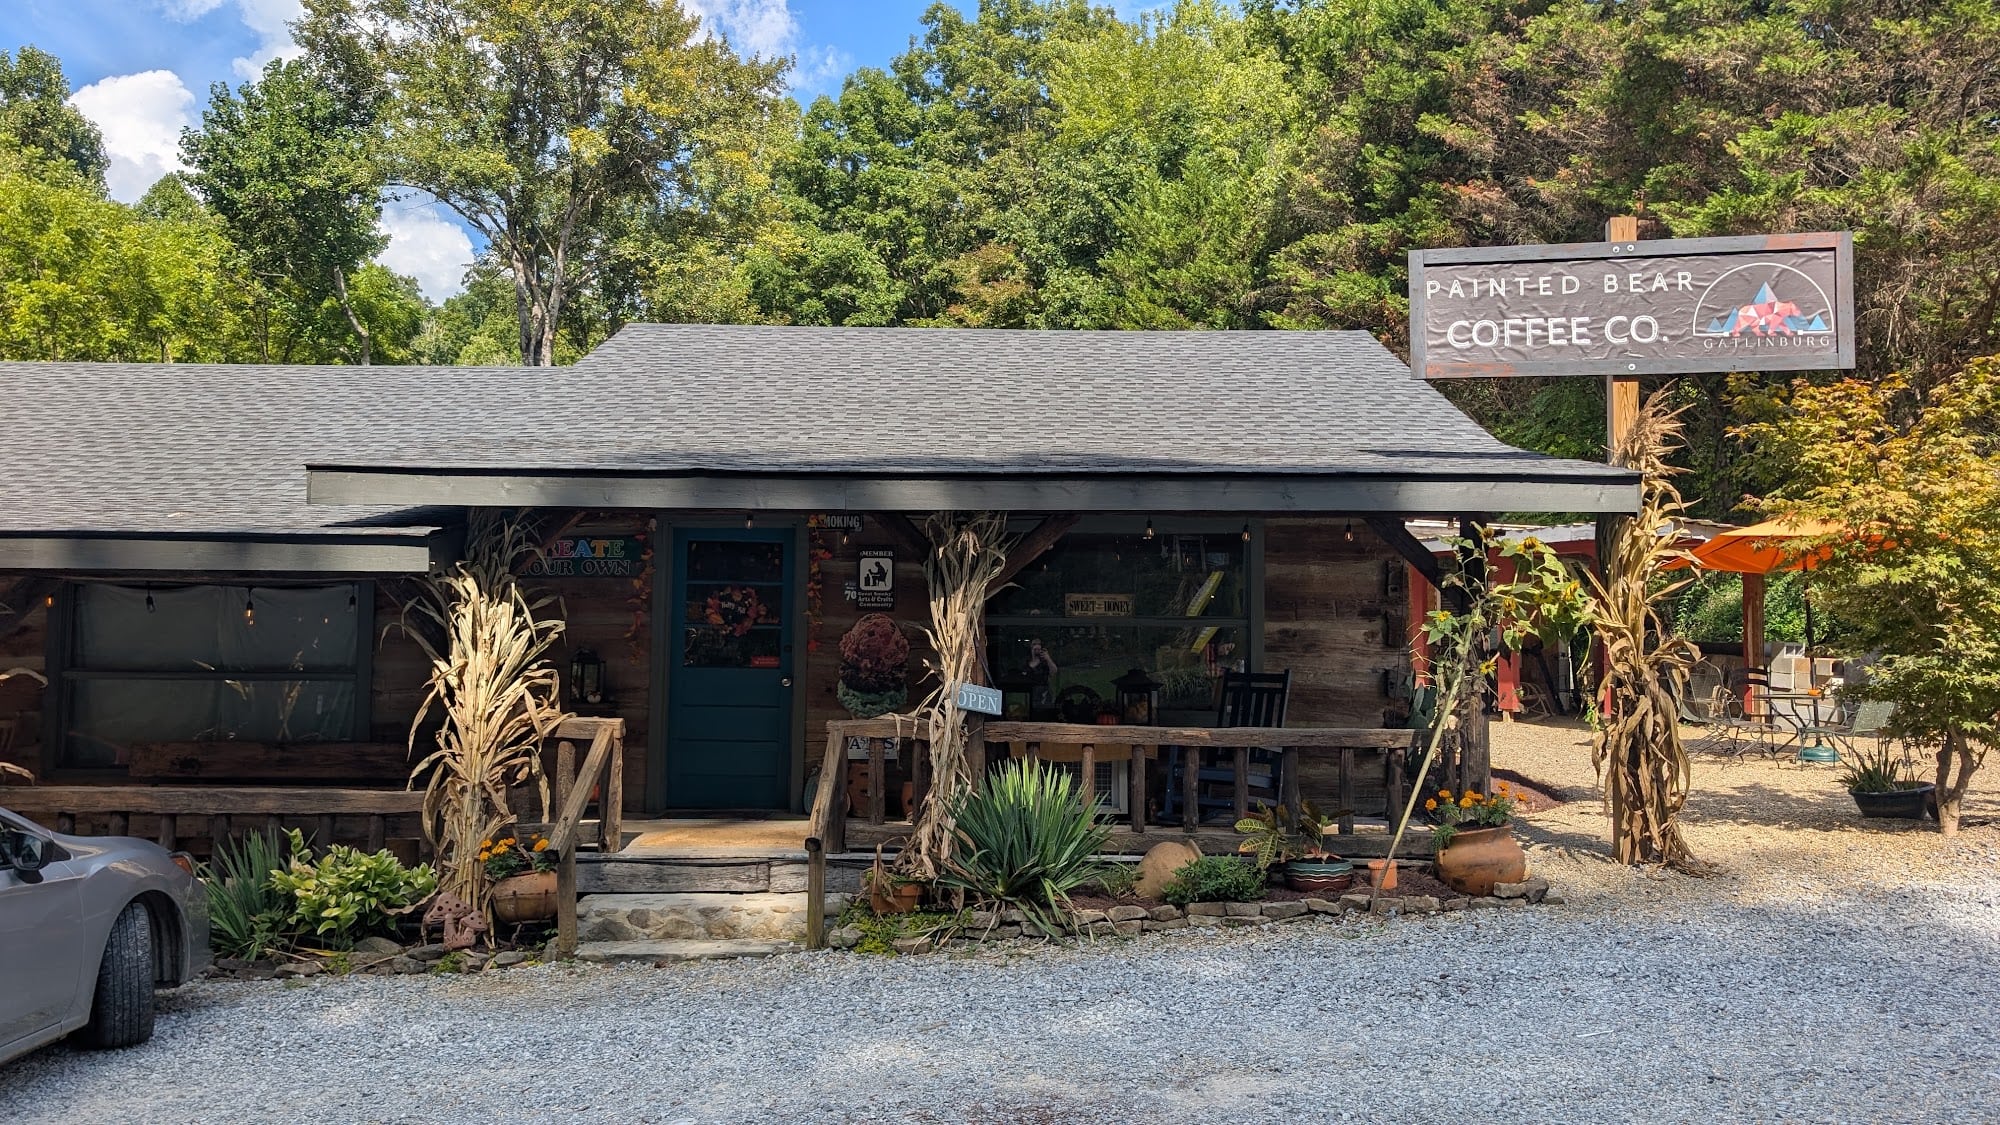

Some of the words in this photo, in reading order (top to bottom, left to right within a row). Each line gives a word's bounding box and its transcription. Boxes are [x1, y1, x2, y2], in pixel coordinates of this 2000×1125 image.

[1426, 275, 1580, 299] PAINTED
[1603, 271, 1693, 294] BEAR
[1446, 316, 1592, 349] COFFEE
[1604, 314, 1669, 345] CO.
[1703, 336, 1830, 349] GATLINBURG
[824, 515, 861, 528] MOKING
[548, 539, 625, 558] EATE
[520, 559, 574, 576] OUR
[582, 559, 631, 575] OWN
[1070, 600, 1096, 612] SWEET
[1104, 600, 1130, 612] HONEY
[957, 690, 998, 713] OPEN
